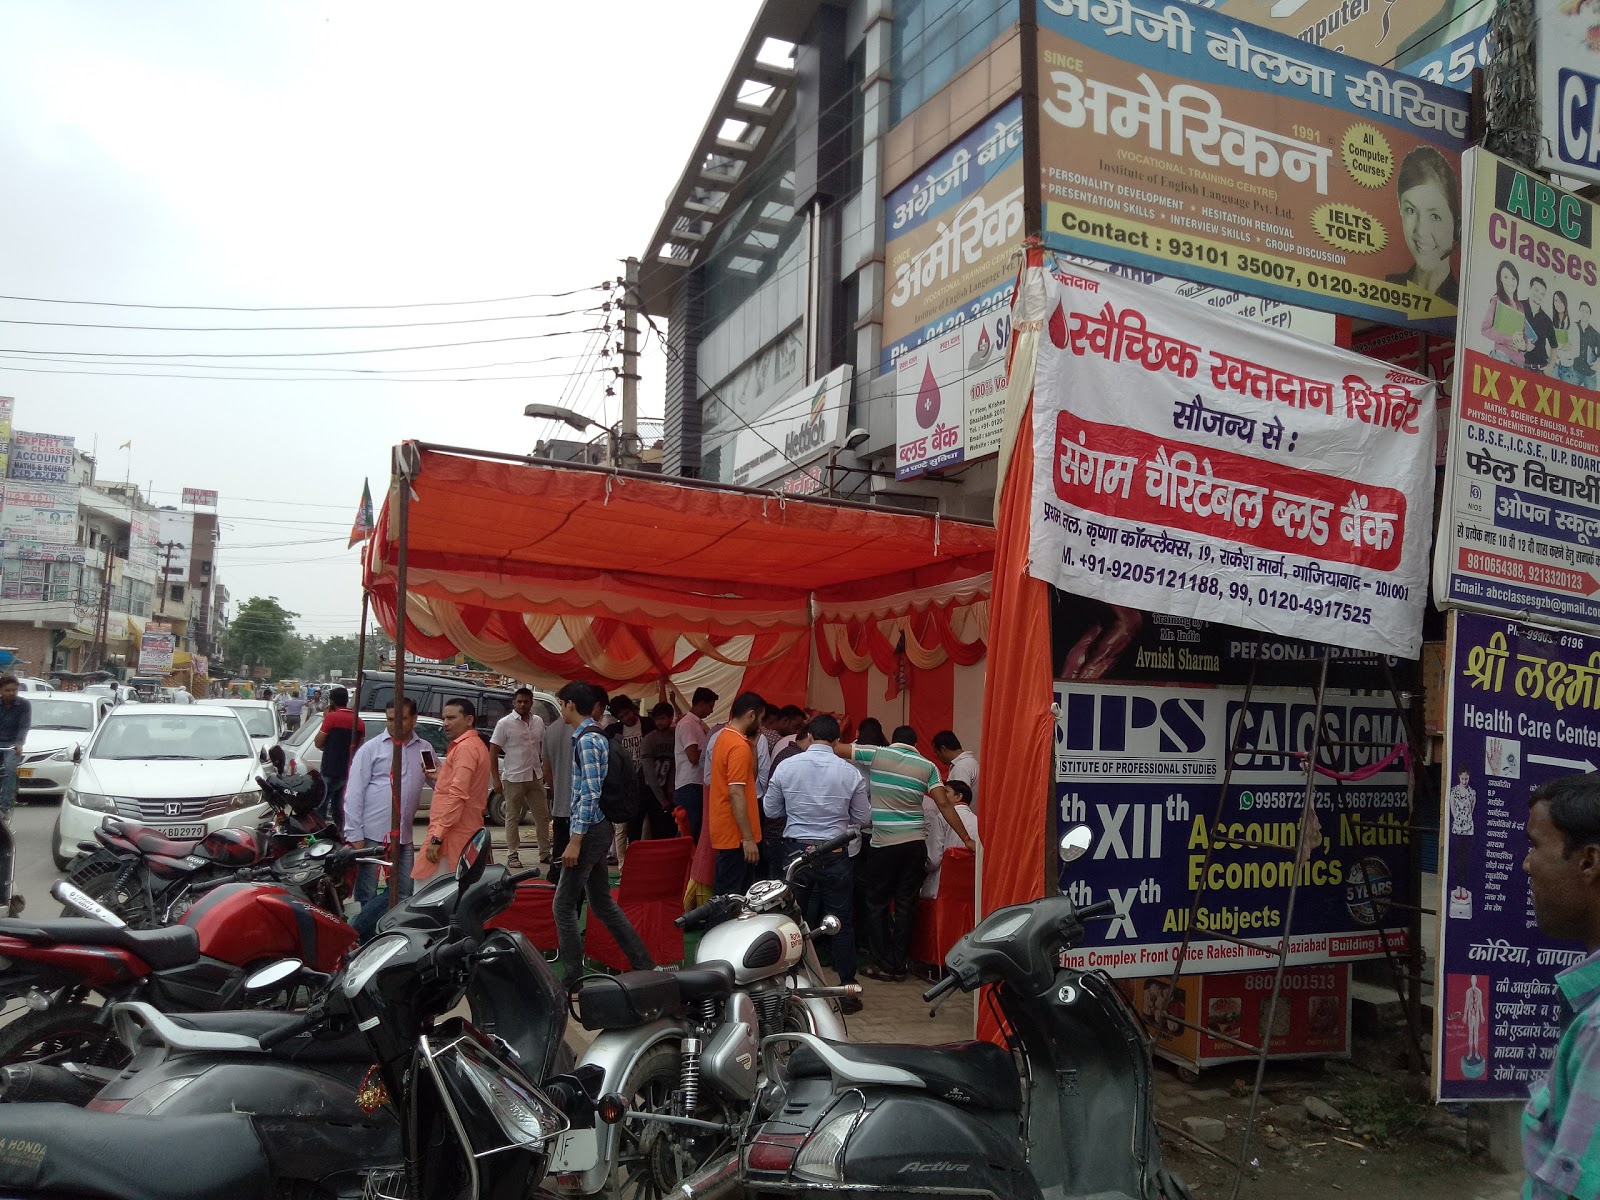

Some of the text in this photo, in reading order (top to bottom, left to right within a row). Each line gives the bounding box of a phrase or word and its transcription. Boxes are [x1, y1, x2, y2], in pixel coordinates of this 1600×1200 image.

[1044, 50, 1083, 72] SINCE
[1045, 0, 1469, 139] अग्रजी बोलना सीखिए
[1043, 71, 1332, 196] अमेरिकन
[1292, 124, 1321, 144] 1991
[1362, 132, 1374, 147] All
[1348, 143, 1388, 165] Computer
[1352, 159, 1386, 178] Courses
[893, 148, 971, 230] अंग्रेजी
[1099, 159, 1145, 181] Institute
[1147, 172, 1159, 185] of
[1161, 176, 1199, 195] English
[1202, 185, 1250, 209] Language
[1275, 208, 1294, 221] Ltd.
[1118, 149, 1279, 201] (VOCATIONAL TRAINING CENTRE)
[1049, 167, 1295, 239] PERSONALITY DEVELOPMENT HESITATION REMOVAL
[1329, 209, 1371, 231] IELTS
[1507, 171, 1581, 240] ABC
[1049, 183, 1346, 265] PRESENTATION SKILLS INTERVIEW SKILLS GROUP DISCUSSION
[1326, 223, 1375, 247] TOEFL
[1061, 211, 1432, 312] Contact 93101 35007, 0120-3209577
[1488, 213, 1597, 287] Classes
[1069, 300, 1422, 435] स्वैच्छिक रक्तदान शिविर
[970, 380, 993, 401] 100%
[1472, 364, 1501, 401] IX
[1508, 376, 1527, 409] X
[1534, 383, 1561, 419] XI
[1172, 394, 1285, 451] सौजन्य से
[1467, 408, 1599, 453] PHYSICS ACCOUNTS
[1484, 402, 1585, 438] MATHS, SCIENCE ENGLISH, S.ST.
[15, 435, 60, 447] EXPERT
[31, 446, 73, 456] CLASSES
[784, 414, 826, 462] Hettich
[899, 422, 960, 463] ब्लड बैंक
[14, 461, 36, 471] MATHS
[37, 463, 43, 471] &
[15, 451, 71, 464] ACCOUNTS
[1466, 447, 1518, 484] फेल
[1551, 448, 1568, 465] U.P.
[1060, 431, 1398, 552] संगम चैरिटेबल ब्लड बैंक
[1496, 492, 1600, 545] ओपन स्कूल
[1044, 501, 1061, 525] प्रथम
[1062, 513, 1082, 536] तल,
[1086, 521, 1118, 547] कृष्णा
[1198, 545, 1214, 563] 19,
[1220, 547, 1253, 571] राकेश
[1257, 555, 1287, 579] मार्ग,
[1293, 561, 1361, 592] गाजियाबाद
[1375, 580, 1409, 601] 201001
[1499, 534, 1507, 547] 10
[1518, 538, 1526, 552] 12
[1080, 553, 1223, 601] +91-9205121188,
[1229, 581, 1253, 606] 99,
[1258, 587, 1372, 625] 0120-4917525
[1454, 579, 1484, 596] Email:
[1467, 553, 1582, 590] 9810654388, 9213320123
[1177, 630, 1201, 642] India
[1136, 645, 1220, 672] Avnish Sharma
[1463, 631, 1600, 711] श्री लक्ष्मी
[1229, 708, 1280, 765] CA
[1296, 711, 1340, 765] CS
[1353, 713, 1408, 765] CMA
[1464, 703, 1513, 734] Health
[1517, 712, 1551, 740] Care
[1102, 762, 1217, 775] OF PROFESSIONAL STUDIES
[1188, 855, 1342, 890] Economics
[1162, 906, 1280, 935] All Subjects
[1088, 938, 1375, 969] Complex Front Rakesh Building
[1468, 939, 1531, 967] कोरिया,
[1245, 975, 1335, 990] 880001513
[1496, 977, 1510, 994] की
[1511, 978, 1551, 999] आधुनिक
[1495, 1020, 1542, 1042] की एडवांस
[1494, 1046, 1525, 1060] माध्यम
[1528, 1043, 1537, 1060] से
[1493, 1064, 1529, 1081] रोगों का
[8, 1138, 47, 1155] HONDA
[897, 1161, 971, 1173] Activa
